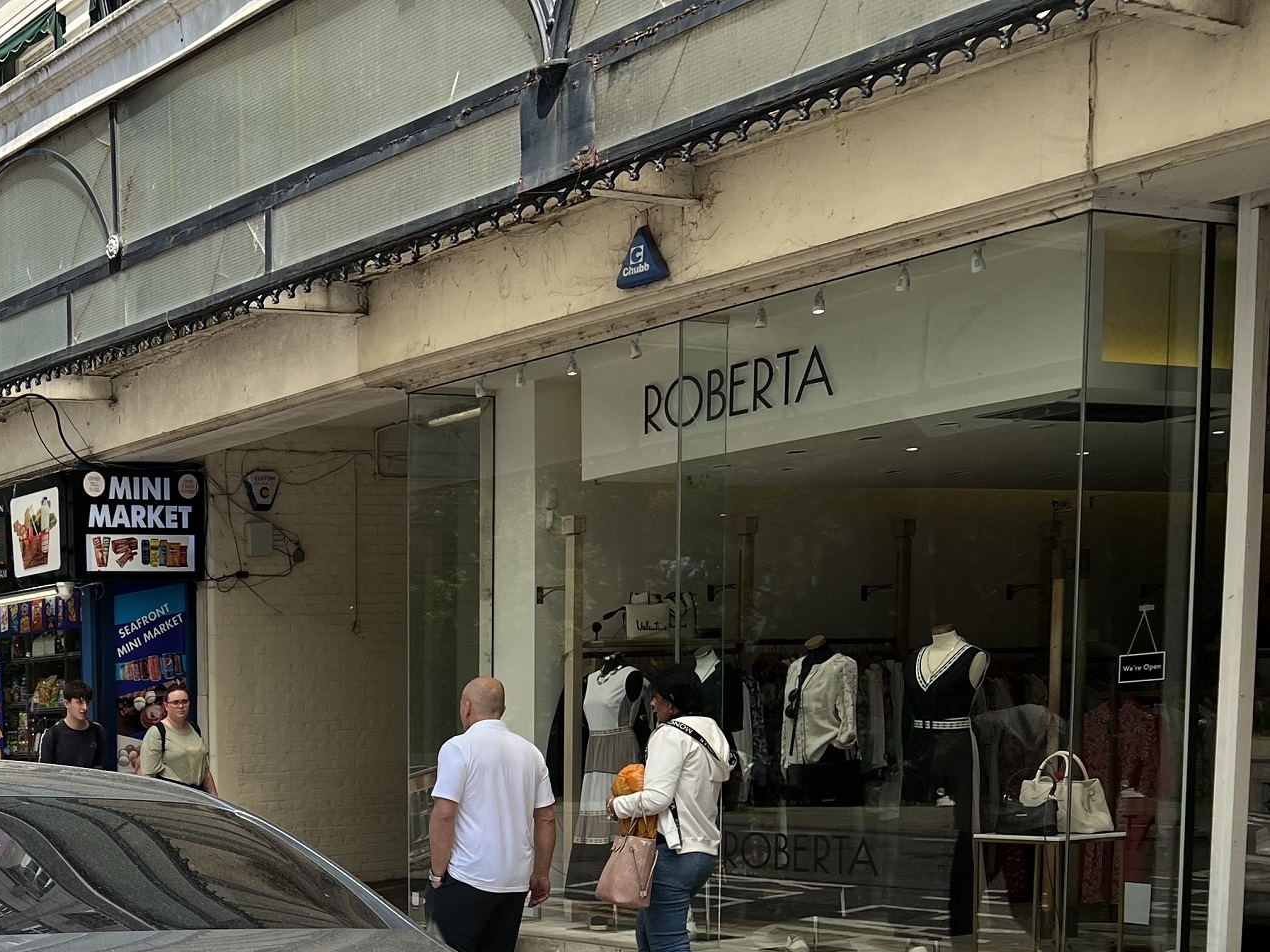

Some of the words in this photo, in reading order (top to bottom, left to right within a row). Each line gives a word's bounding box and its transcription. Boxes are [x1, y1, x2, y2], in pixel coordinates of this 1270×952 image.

[623, 262, 650, 277] Chubb
[644, 345, 834, 434] ROBERTA
[109, 476, 170, 500] MINI
[88, 504, 192, 529] MARKET
[117, 636, 142, 658] MINI
[143, 613, 184, 643] MARKET
[118, 603, 171, 639] SEAFRONT
[1143, 663, 1162, 672] Open
[722, 831, 879, 877] ROBERTA
